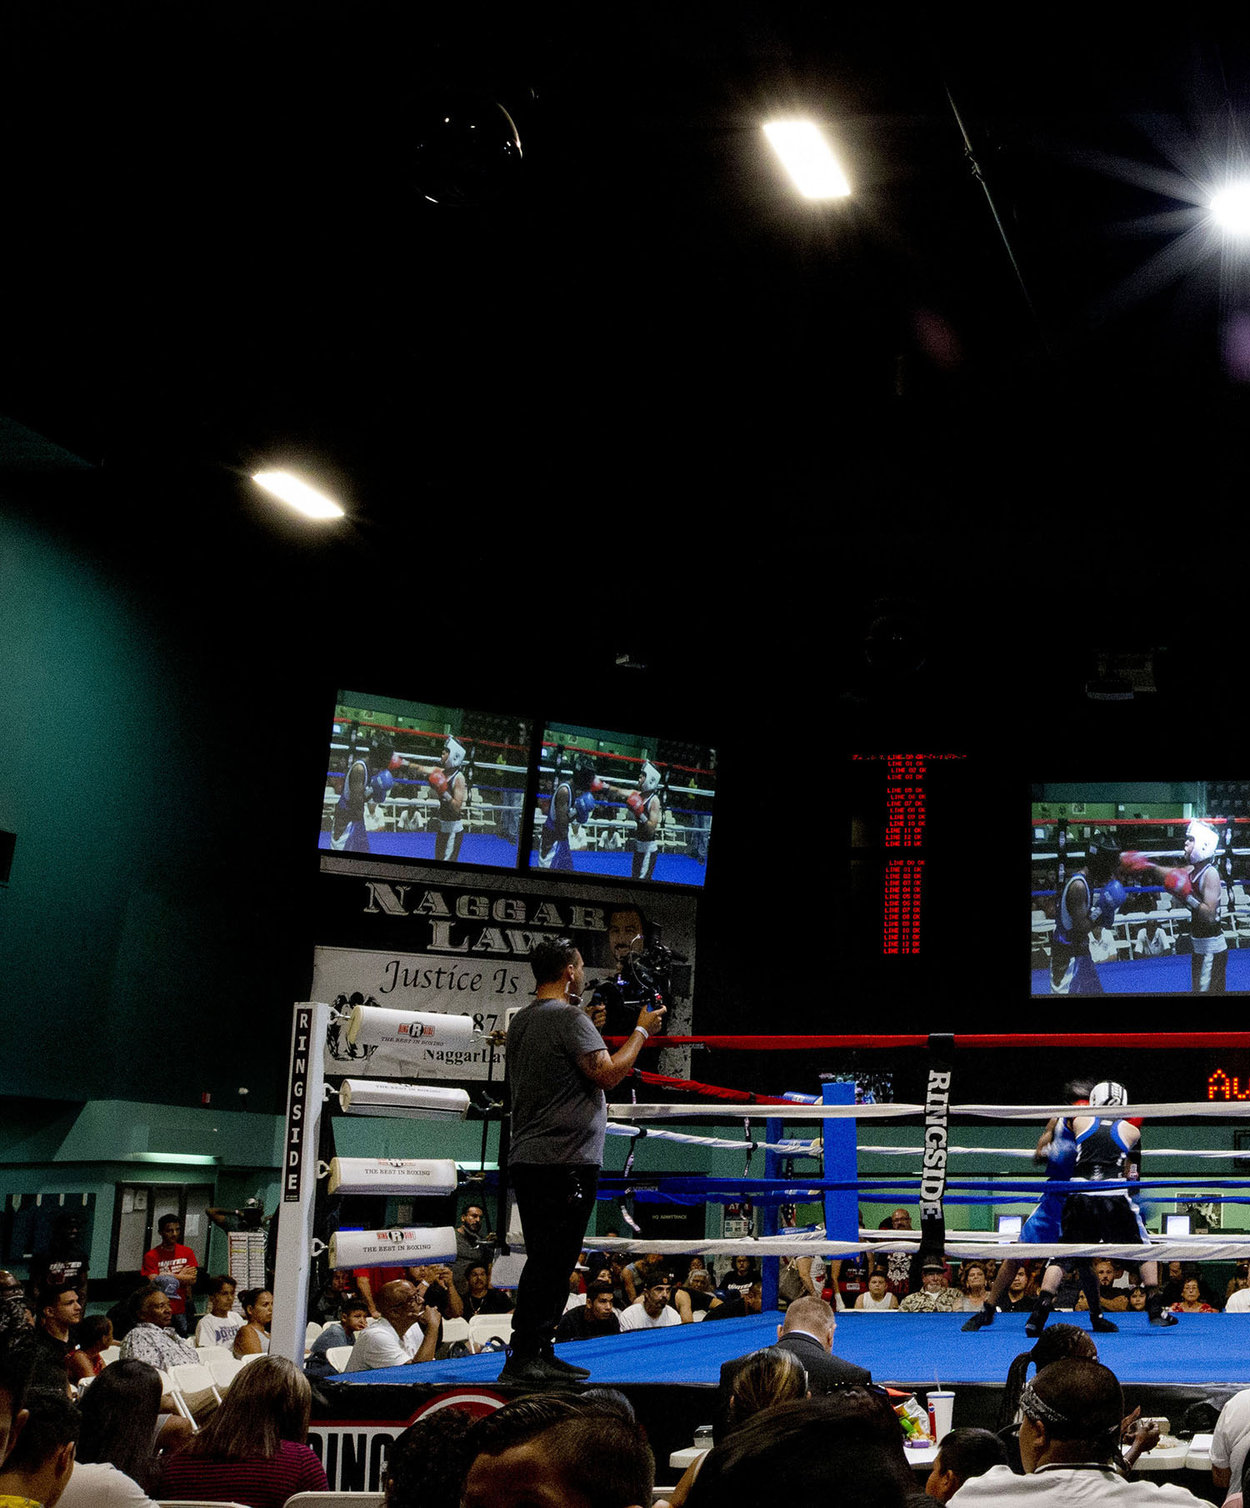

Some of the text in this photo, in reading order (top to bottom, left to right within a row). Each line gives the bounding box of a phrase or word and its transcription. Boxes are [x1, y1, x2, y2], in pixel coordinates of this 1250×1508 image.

[363, 881, 608, 932] NAGGAR
[427, 919, 560, 955] LAW
[380, 960, 519, 994] Justice Is
[288, 1013, 308, 1190] RINGSIDE
[919, 1069, 951, 1220] RINGSIDE
